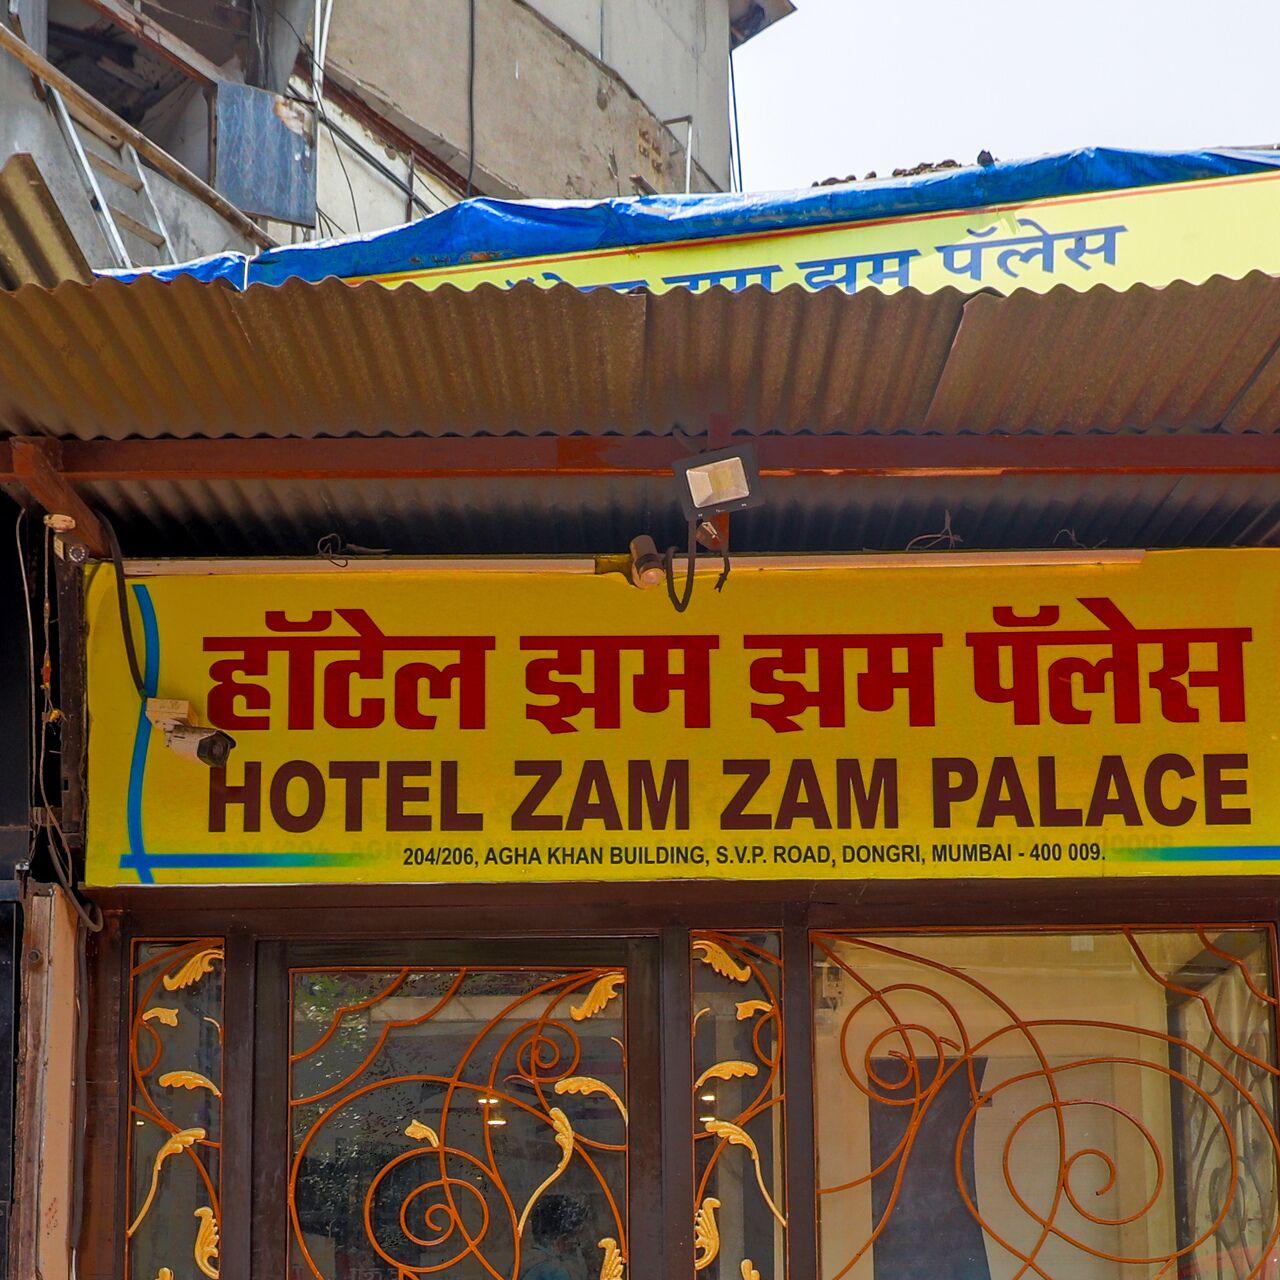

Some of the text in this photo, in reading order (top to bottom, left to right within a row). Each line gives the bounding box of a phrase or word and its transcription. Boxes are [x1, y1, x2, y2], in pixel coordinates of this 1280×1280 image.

[202, 608, 496, 731] हॉटेल
[520, 634, 719, 735] झम
[743, 632, 943, 733] झम
[207, 753, 1252, 833] HOTEL ZAM ZAM PALACE
[403, 847, 479, 868] 204/206,
[485, 847, 543, 866] AGHA
[547, 846, 604, 865] KHAN
[610, 846, 710, 868] BUILDING,
[716, 845, 768, 865] S.V.P.
[774, 845, 836, 868] ROAD,
[842, 844, 926, 866] DONGRI,
[932, 843, 1012, 862] MUMBAI
[1030, 843, 1062, 861] 400
[1068, 842, 1106, 861] 009.
